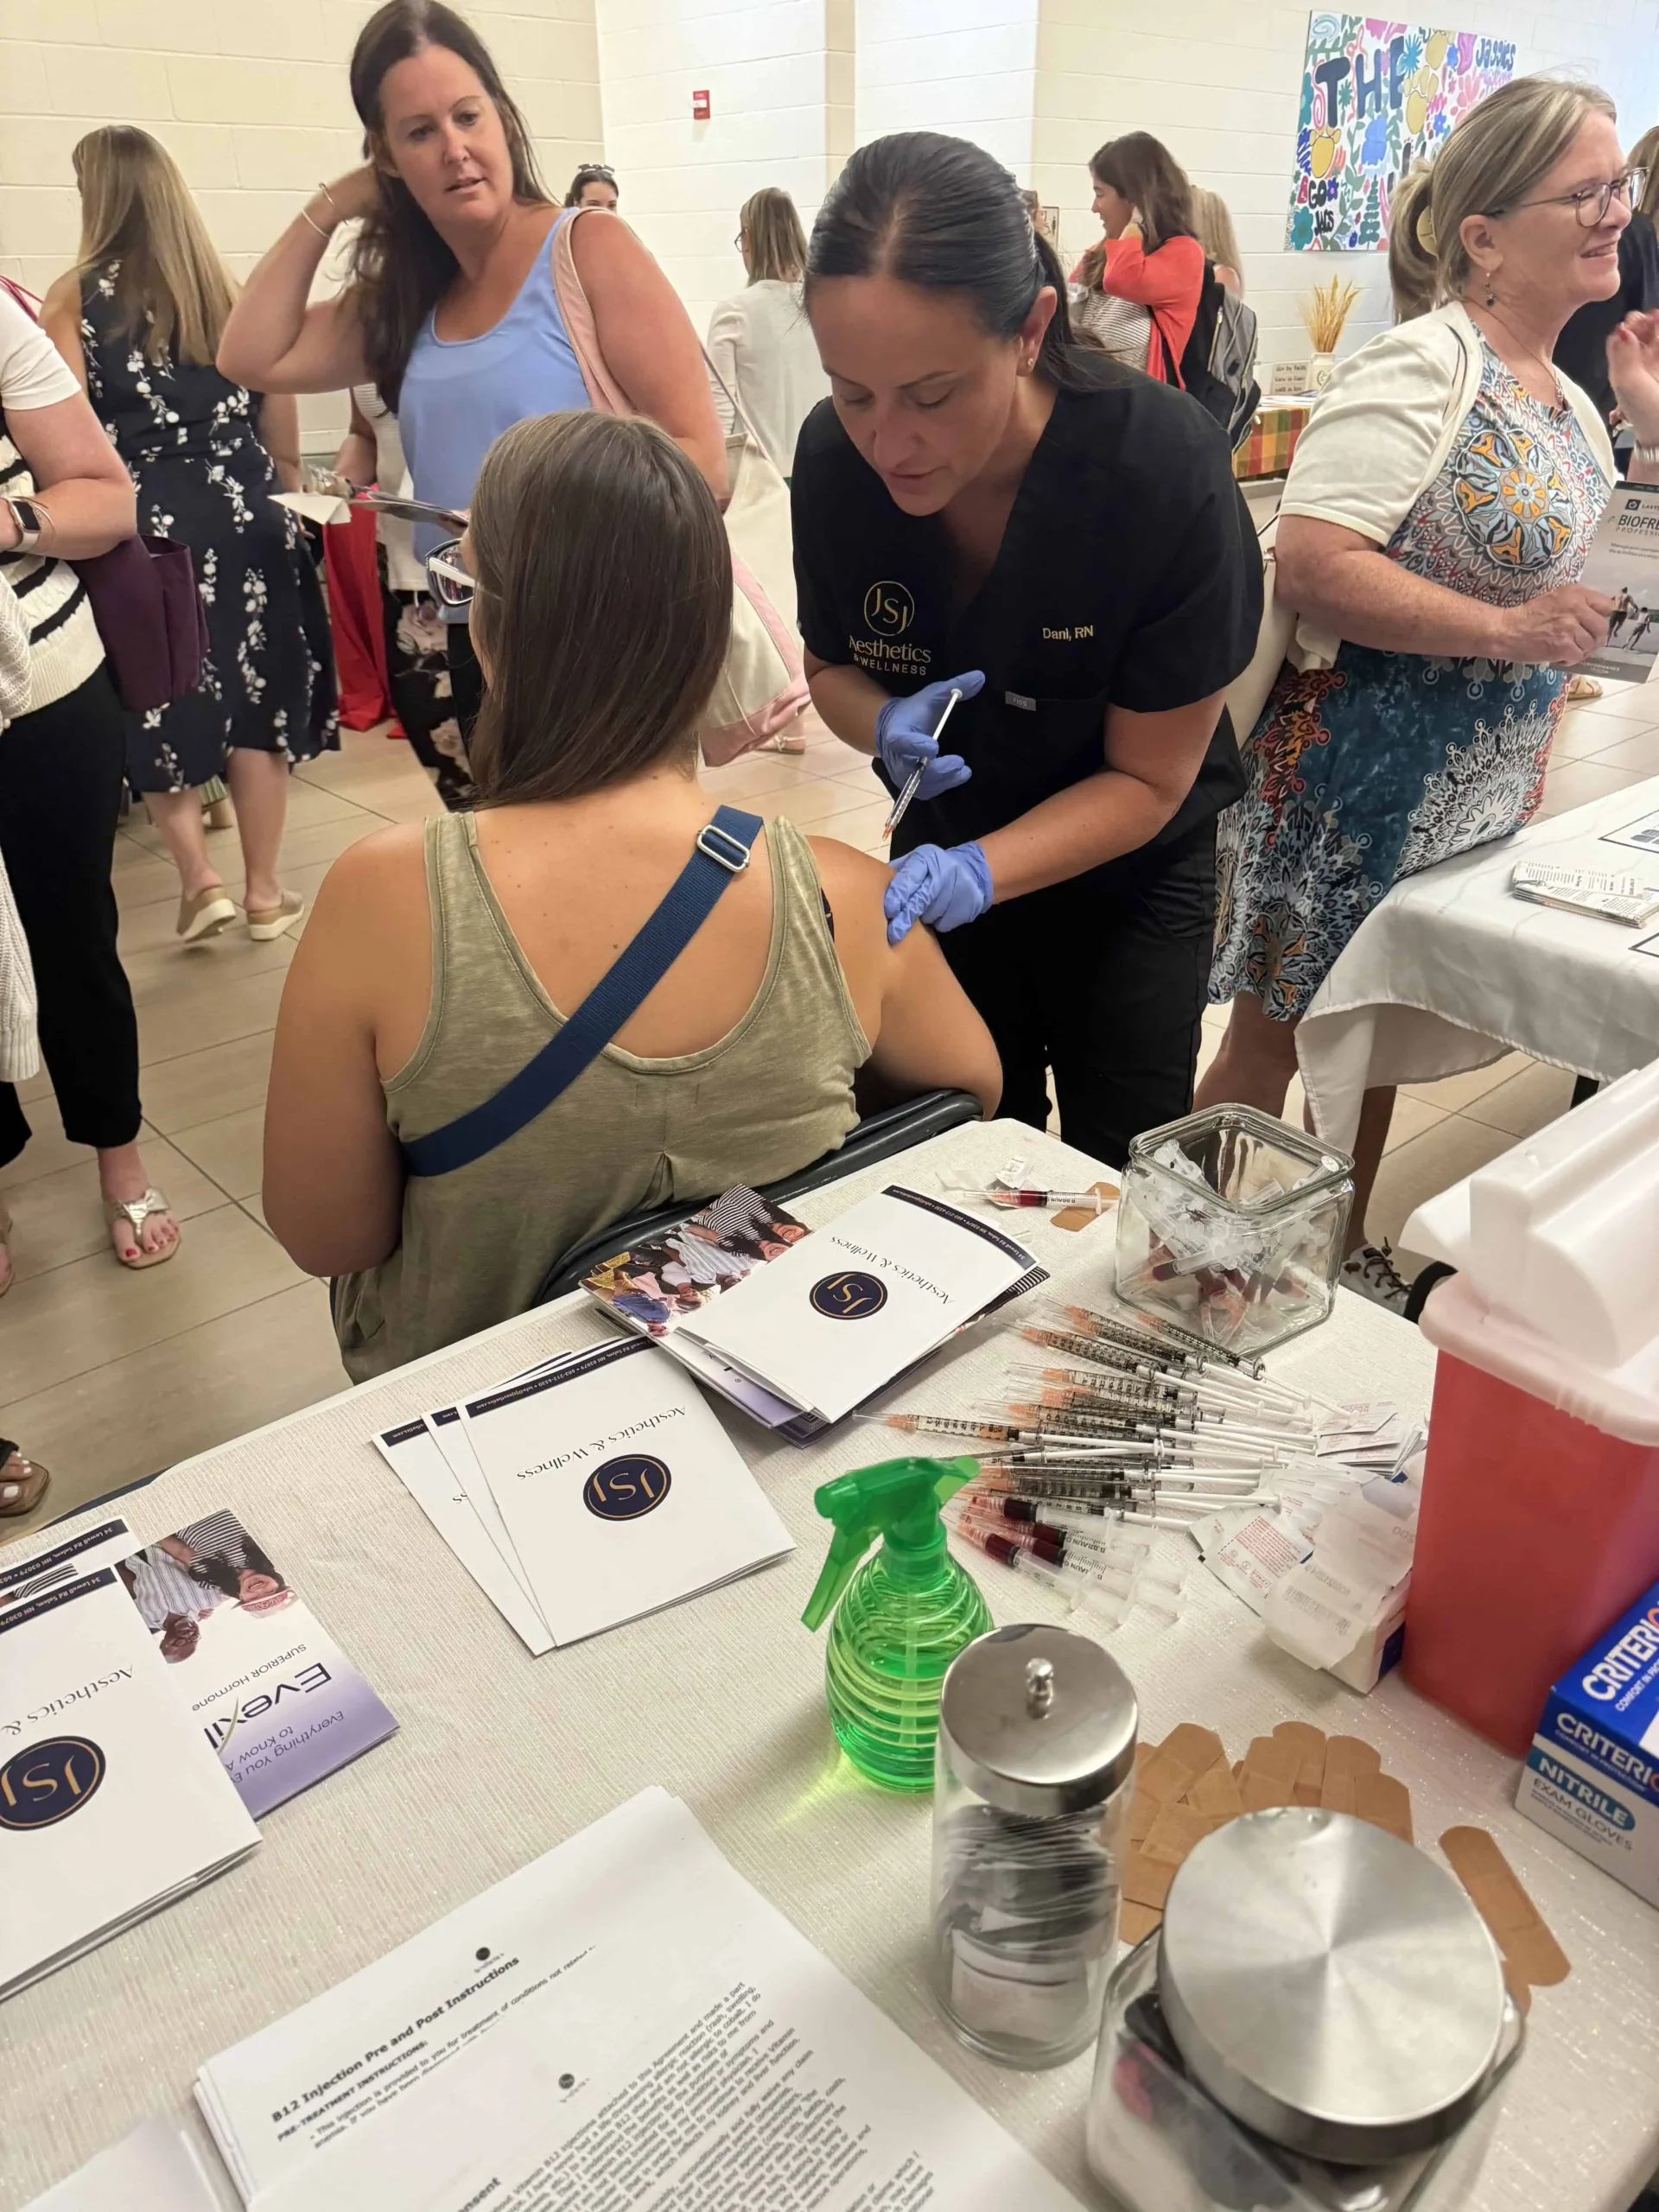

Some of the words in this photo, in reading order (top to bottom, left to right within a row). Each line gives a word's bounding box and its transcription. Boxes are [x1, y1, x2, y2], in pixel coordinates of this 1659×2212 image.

[1308, 180, 1327, 209] GO
[871, 588, 907, 633] JSJ
[1042, 626, 1072, 641] Dani,
[1075, 625, 1094, 639] RN
[849, 635, 931, 664] Aesthetics
[832, 1236, 876, 1262] Wellness
[880, 1257, 892, 1267] &
[894, 1265, 948, 1304] Aesthetics
[608, 1408, 684, 1440] Aesthetics
[589, 1440, 604, 1450] &
[517, 1448, 588, 1478] Wellness
[588, 1454, 658, 1516] JSJ
[50, 1546, 73, 1557] Salem,
[83, 1531, 103, 1544] Lowell
[19, 1562, 41, 1575] 03079
[35, 1595, 57, 1606] Salem,
[68, 1580, 90, 1593] Lowell
[23, 1605, 35, 1614] NH
[251, 1644, 306, 1677] SUPERIOR
[27, 1669, 131, 1719] Aesthetics
[192, 1675, 249, 1711] Hormone
[1, 1720, 21, 1735] &
[273, 1711, 343, 1757] Everything
[278, 1726, 293, 1738] to
[239, 1736, 276, 1763] Know
[245, 1756, 271, 1774] You
[1539, 1758, 1627, 1825] NITRILE
[1531, 1777, 1573, 1808] EXAM
[1572, 1805, 1635, 1851] GLOVES
[272, 2100, 299, 2121] B12
[302, 2061, 362, 2101] Injection
[365, 2044, 388, 2062] Pre
[391, 2025, 413, 2045] and
[416, 2006, 443, 2028] Post
[445, 1958, 518, 2008] Instructions
[357, 2042, 427, 2088] INSTRUCTIONS:
